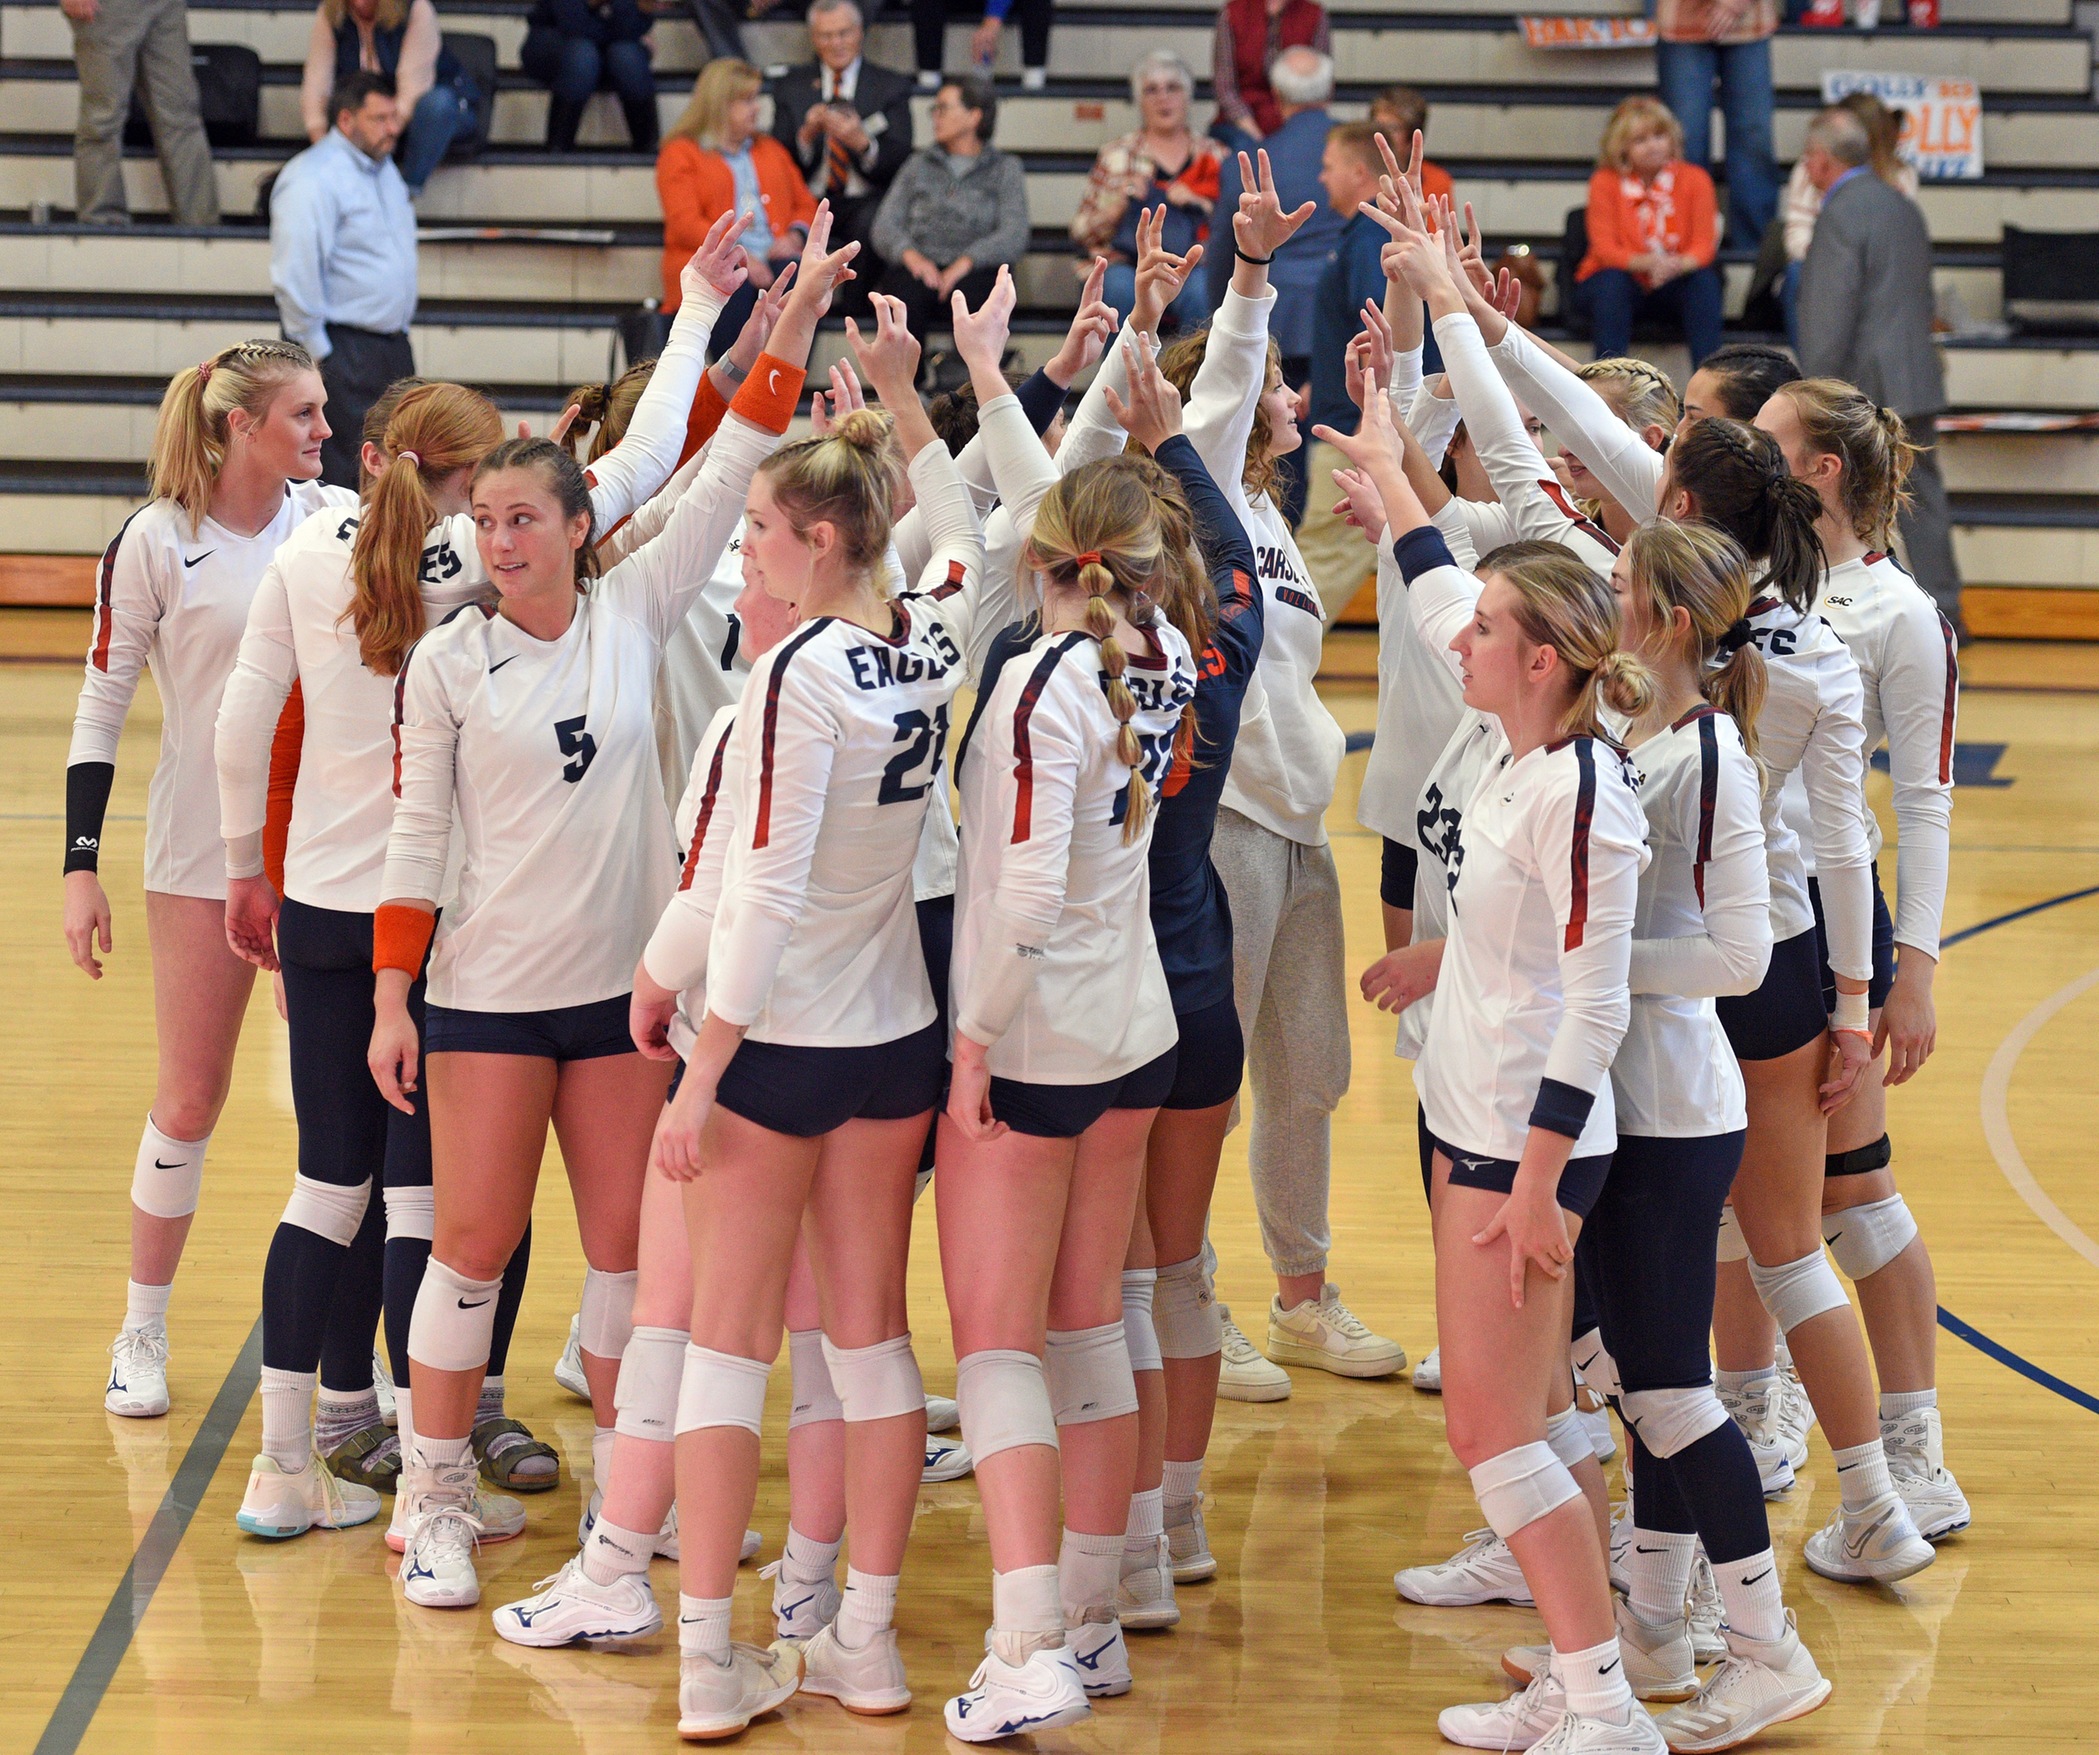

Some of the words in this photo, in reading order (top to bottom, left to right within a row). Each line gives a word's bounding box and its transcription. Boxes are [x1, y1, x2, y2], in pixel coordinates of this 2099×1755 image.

[1827, 595, 1853, 607] SAC
[845, 622, 961, 690] EAGLS
[553, 714, 598, 784] 5
[877, 702, 949, 806] 21
